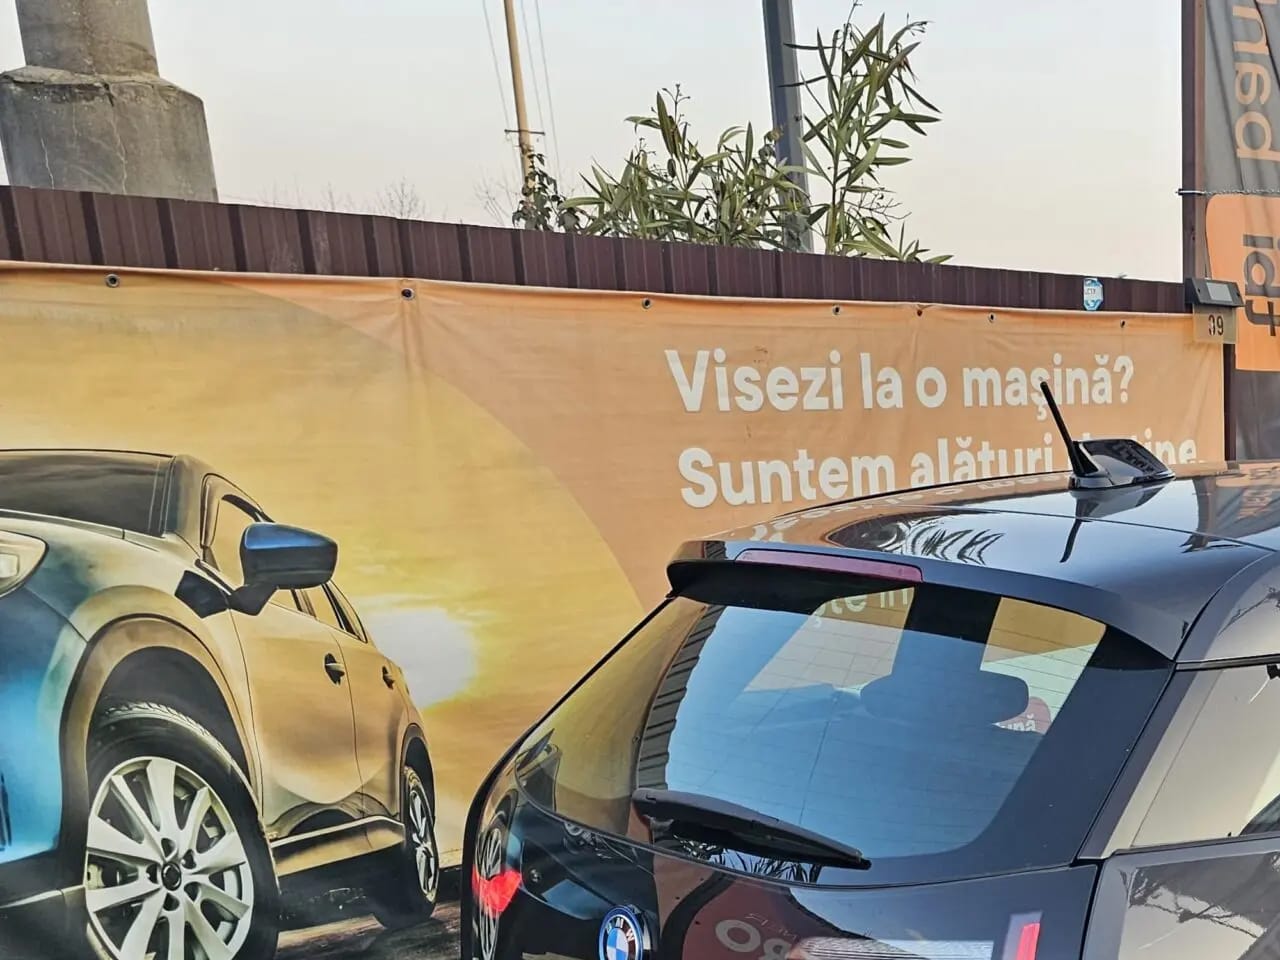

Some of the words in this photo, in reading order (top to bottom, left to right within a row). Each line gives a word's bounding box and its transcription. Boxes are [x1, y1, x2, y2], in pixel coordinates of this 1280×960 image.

[665, 348, 844, 412] Visezi
[860, 352, 904, 409] la
[916, 366, 947, 408] o
[962, 352, 1134, 421] mașină?
[678, 447, 896, 508] Suntem
[910, 432, 1053, 491] alături
